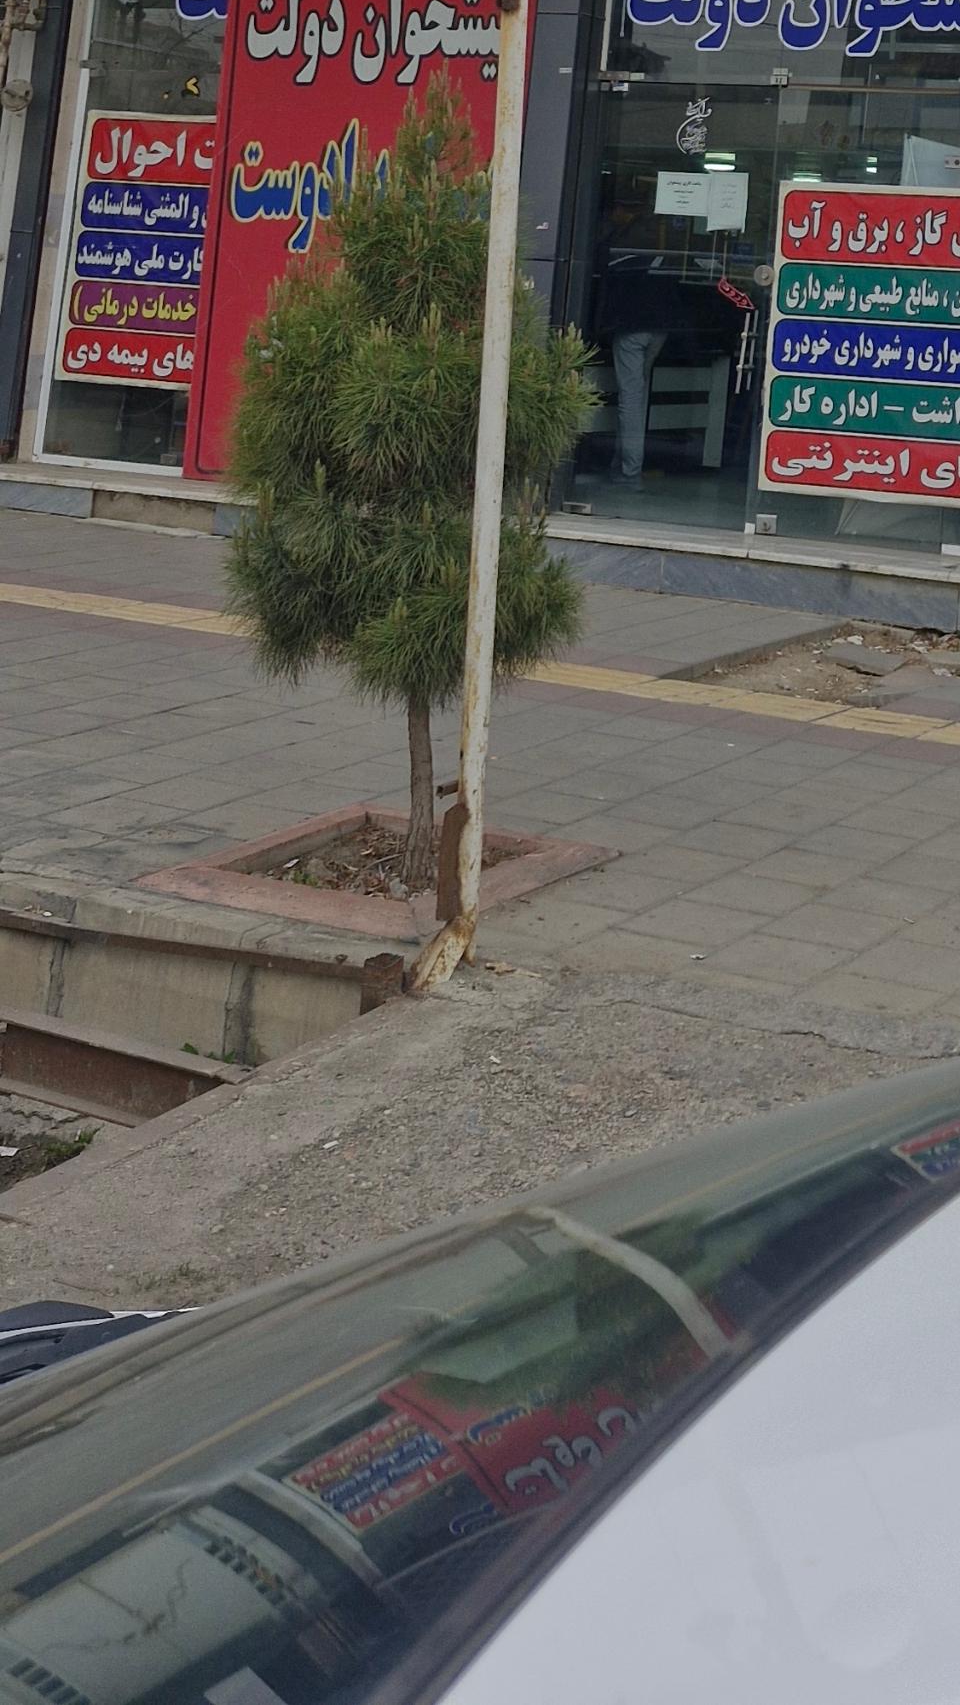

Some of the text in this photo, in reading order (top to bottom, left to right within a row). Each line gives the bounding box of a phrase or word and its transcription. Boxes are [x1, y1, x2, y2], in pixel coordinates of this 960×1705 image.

[94, 126, 188, 177] احوال
[87, 189, 143, 216] شناسنامه
[787, 200, 827, 247] آب
[828, 220, 843, 252] و
[848, 212, 889, 253] برق
[909, 209, 948, 255] گاز
[77, 242, 132, 275] هوشمند
[134, 243, 165, 277] ملی
[141, 292, 197, 321] خدمات
[785, 272, 846, 310] شهرداری
[846, 286, 857, 312] و
[859, 275, 904, 312] طبیعی
[905, 278, 939, 315] منابع
[66, 342, 101, 370] دی
[106, 343, 148, 374] بیمه
[781, 329, 832, 364] خودرو
[834, 331, 902, 369] شهرداری
[904, 345, 915, 371] و
[778, 384, 816, 422] کار
[820, 388, 878, 426] اداره
[771, 441, 911, 485] اینترنتی
